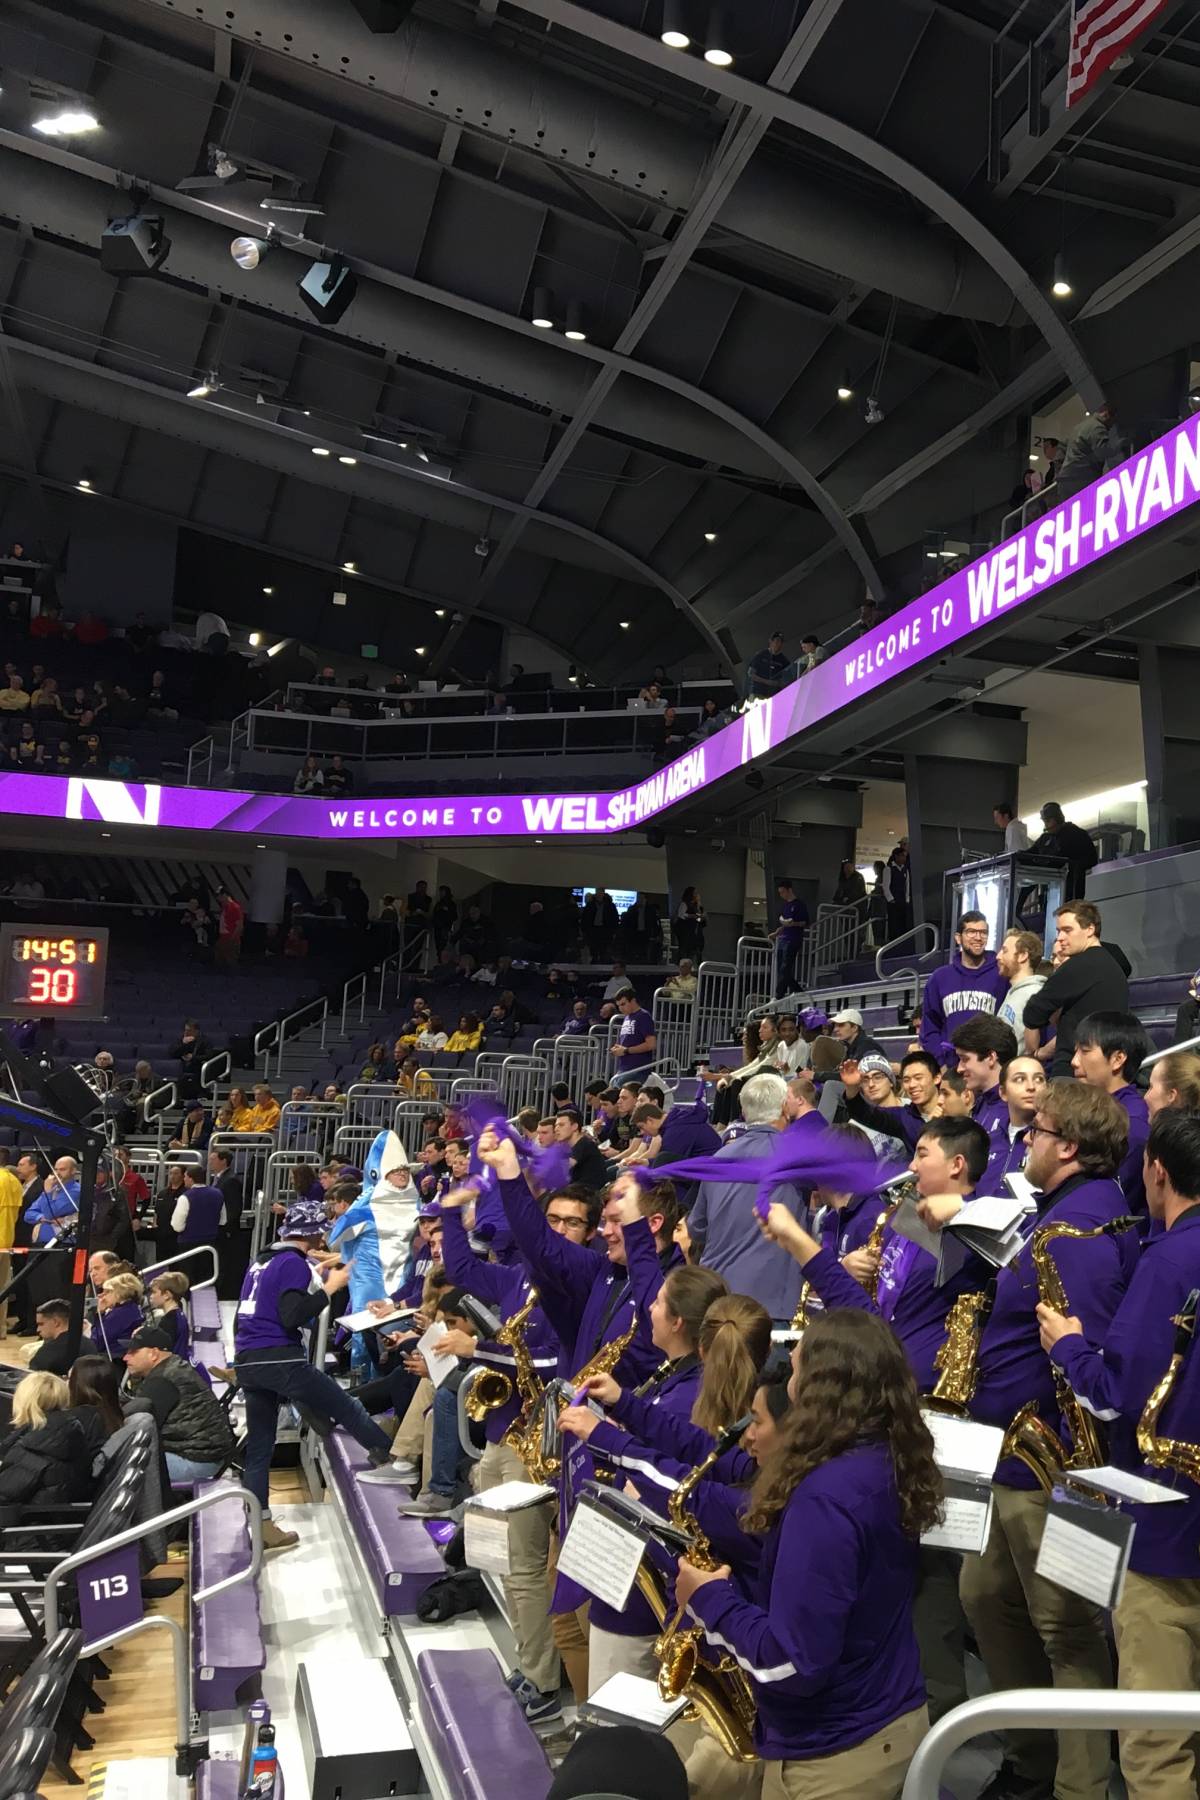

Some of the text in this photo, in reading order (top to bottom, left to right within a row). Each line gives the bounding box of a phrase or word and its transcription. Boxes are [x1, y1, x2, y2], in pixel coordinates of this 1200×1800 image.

[845, 618, 921, 686] WELCOME
[931, 598, 953, 633] TO
[741, 697, 773, 764] N
[65, 777, 161, 825] N
[329, 747, 706, 831] WELCOME TO WELSH-RYAN ARENA
[23, 939, 95, 965] 14:51
[30, 968, 75, 1003] 30
[90, 1575, 129, 1600] 113
